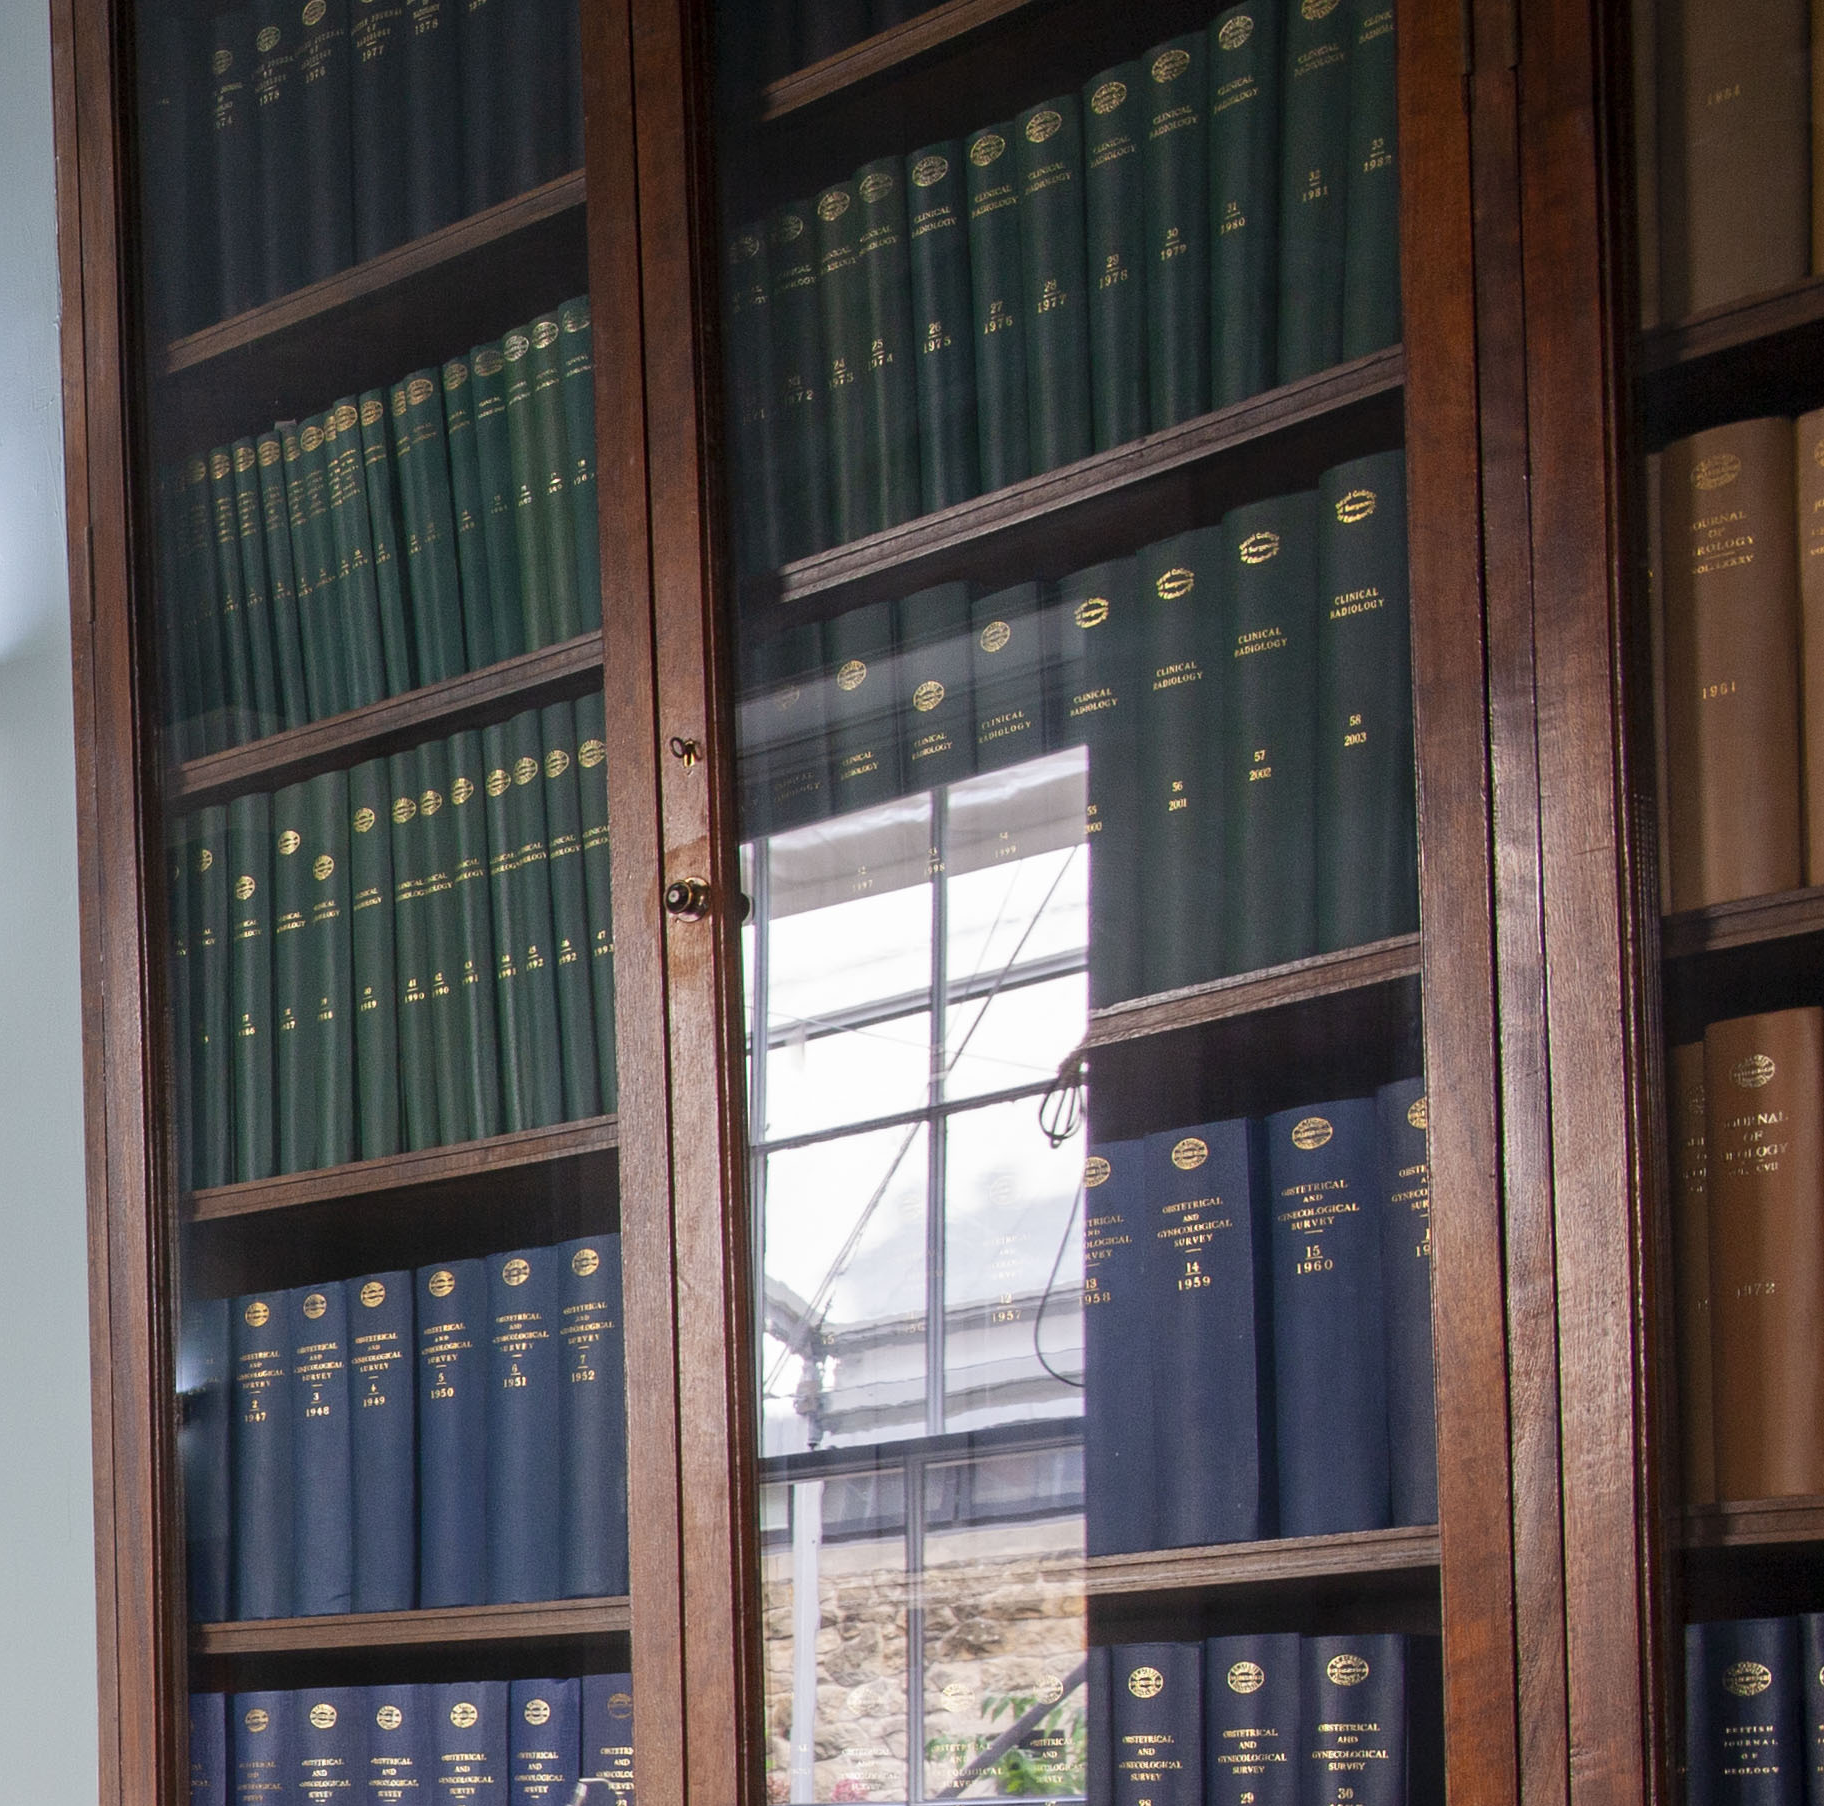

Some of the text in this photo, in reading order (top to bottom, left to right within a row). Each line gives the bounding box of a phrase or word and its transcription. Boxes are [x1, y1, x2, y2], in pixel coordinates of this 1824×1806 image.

[1334, 587, 1379, 606] CLINICAL
[1330, 599, 1384, 620] RADIOLOGY
[1238, 627, 1282, 644] CLINICAL
[1234, 638, 1287, 658] RADIOLOGY
[1156, 661, 1197, 677] CLINICAL
[1153, 671, 1203, 691] RADIOLOGY
[1349, 714, 1361, 726] 58
[1344, 732, 1367, 746] 2003
[1254, 750, 1266, 762] 57
[1305, 1245, 1320, 1258] 15
[1185, 1261, 1199, 1273] 14
[1296, 1260, 1334, 1275] 1960
[1177, 1275, 1211, 1291] 1959
